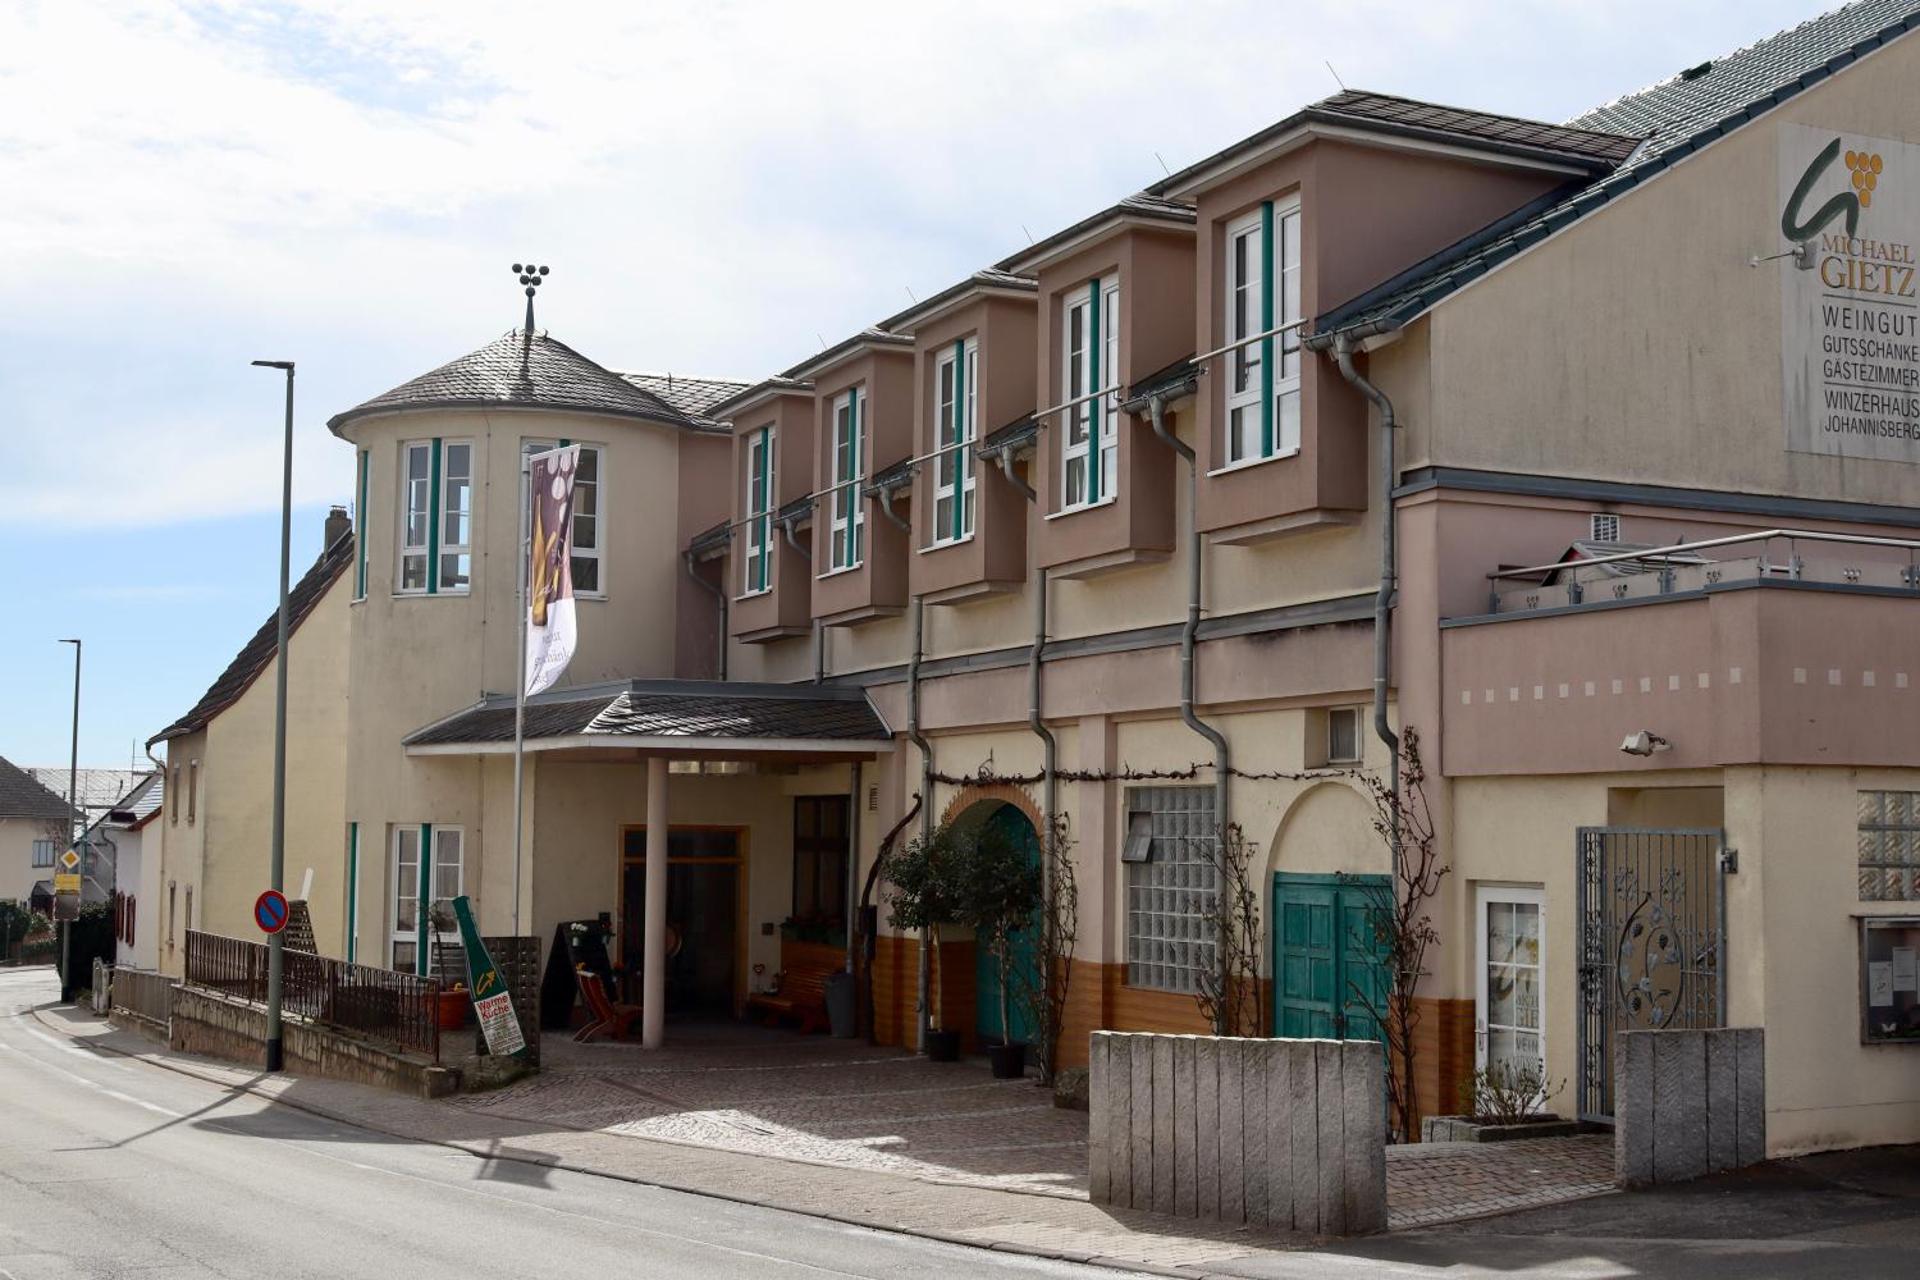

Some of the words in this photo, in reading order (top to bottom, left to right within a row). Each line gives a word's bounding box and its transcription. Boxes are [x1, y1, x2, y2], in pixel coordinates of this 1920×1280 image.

[1822, 233, 1915, 264] MICHAEL
[1821, 256, 1916, 297] GIETZ
[1822, 305, 1918, 337] WEINGUT
[1823, 335, 1919, 362] GUTSSCHÄNKE
[1823, 358, 1919, 387] GÄSTEZIMMER
[1825, 390, 1920, 418] WINZERHAUS
[1825, 415, 1920, 440] JOHANNISBERG
